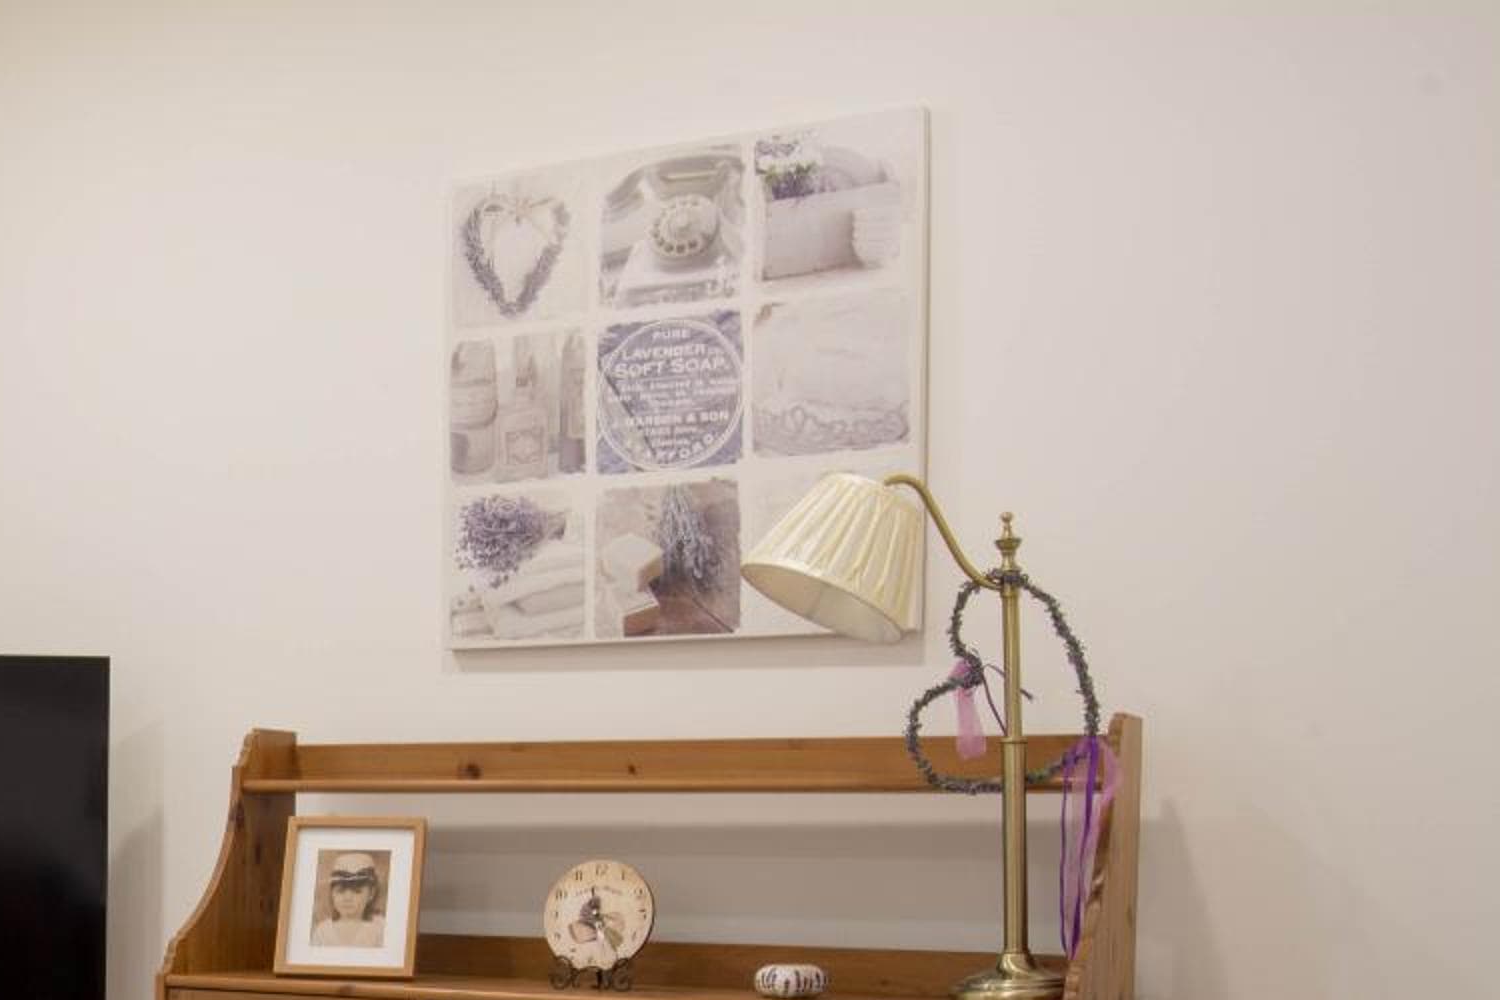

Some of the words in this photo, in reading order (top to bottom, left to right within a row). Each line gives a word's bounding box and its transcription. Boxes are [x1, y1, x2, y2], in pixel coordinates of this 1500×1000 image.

[652, 329, 692, 341] PURE
[621, 343, 707, 361] LAVENDER
[614, 361, 664, 378] SOFT
